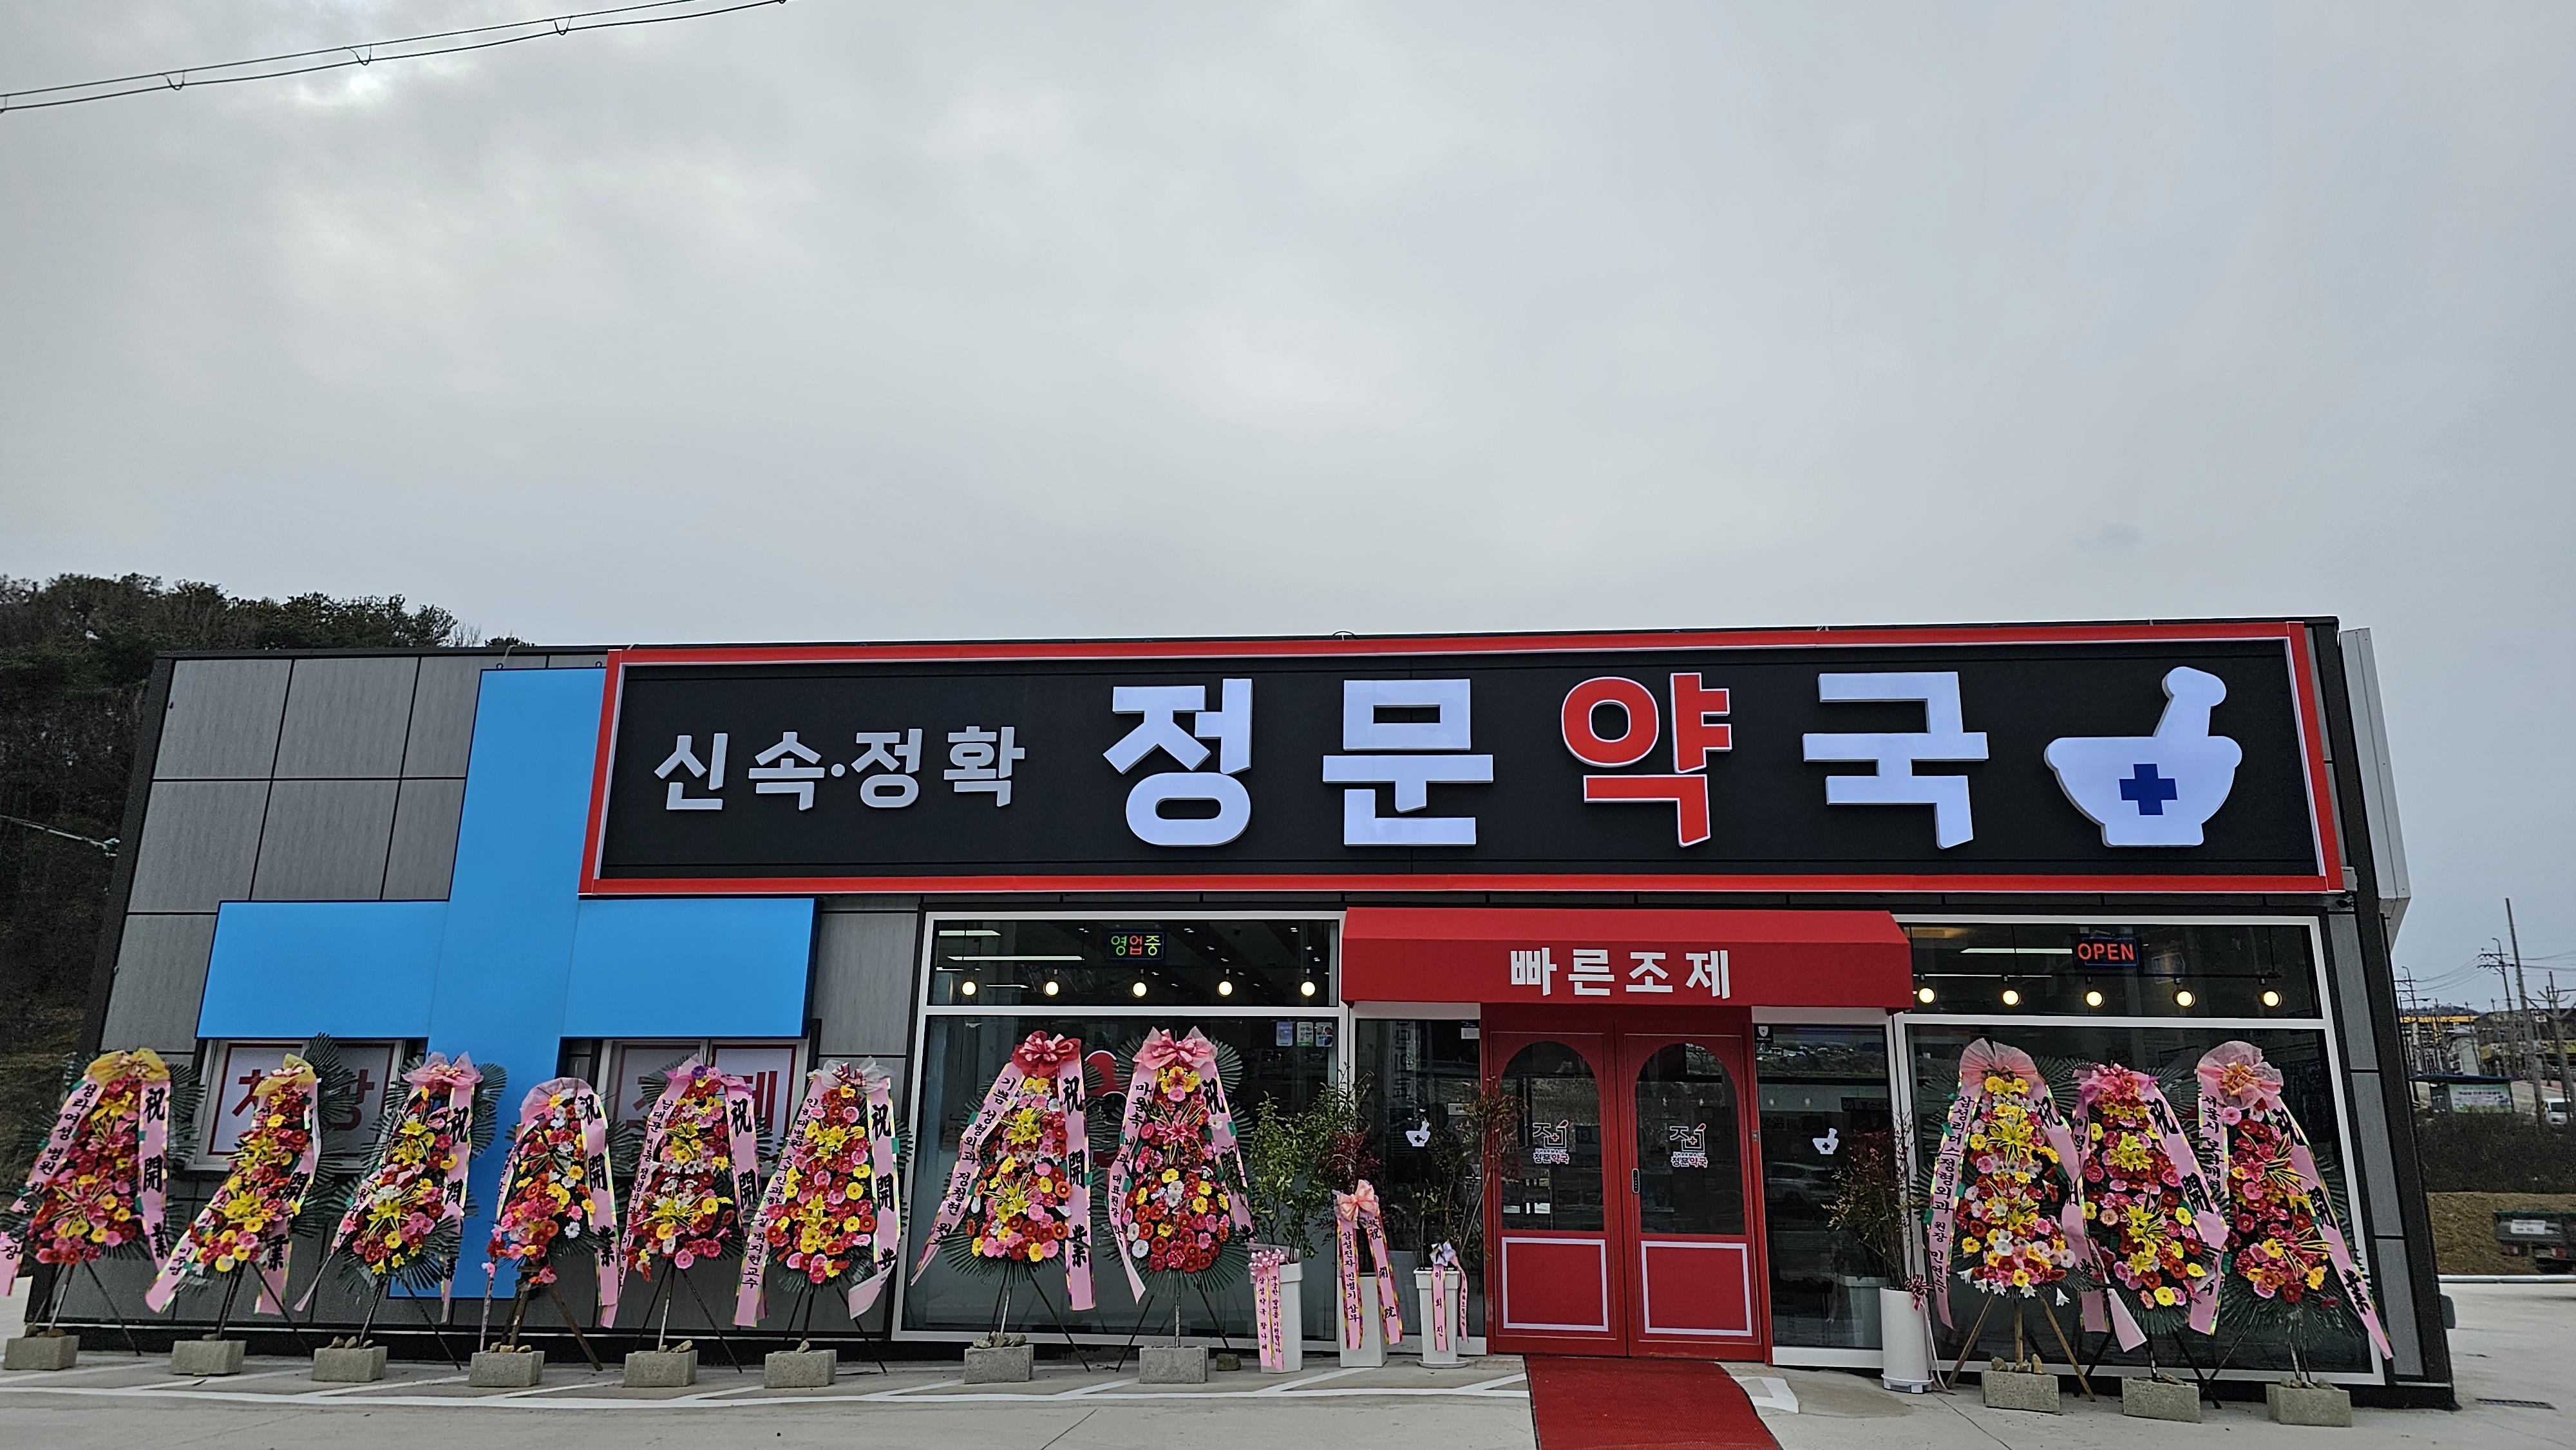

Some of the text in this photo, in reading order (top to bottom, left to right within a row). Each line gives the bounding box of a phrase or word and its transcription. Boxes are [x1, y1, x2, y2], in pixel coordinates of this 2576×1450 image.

[1103, 672, 1989, 849] 정문약국
[1111, 936, 1161, 956] 영업중
[2078, 943, 2134, 960] OPEN
[961, 1109, 996, 1165] 정형외과
[1533, 1153, 1569, 1164] 정문약국
[1671, 1156, 1708, 1168] 정문약국
[1342, 1231, 1356, 1267] 삼성전자
[742, 1267, 759, 1289] 교수
[1347, 1304, 1361, 1323] 상무
